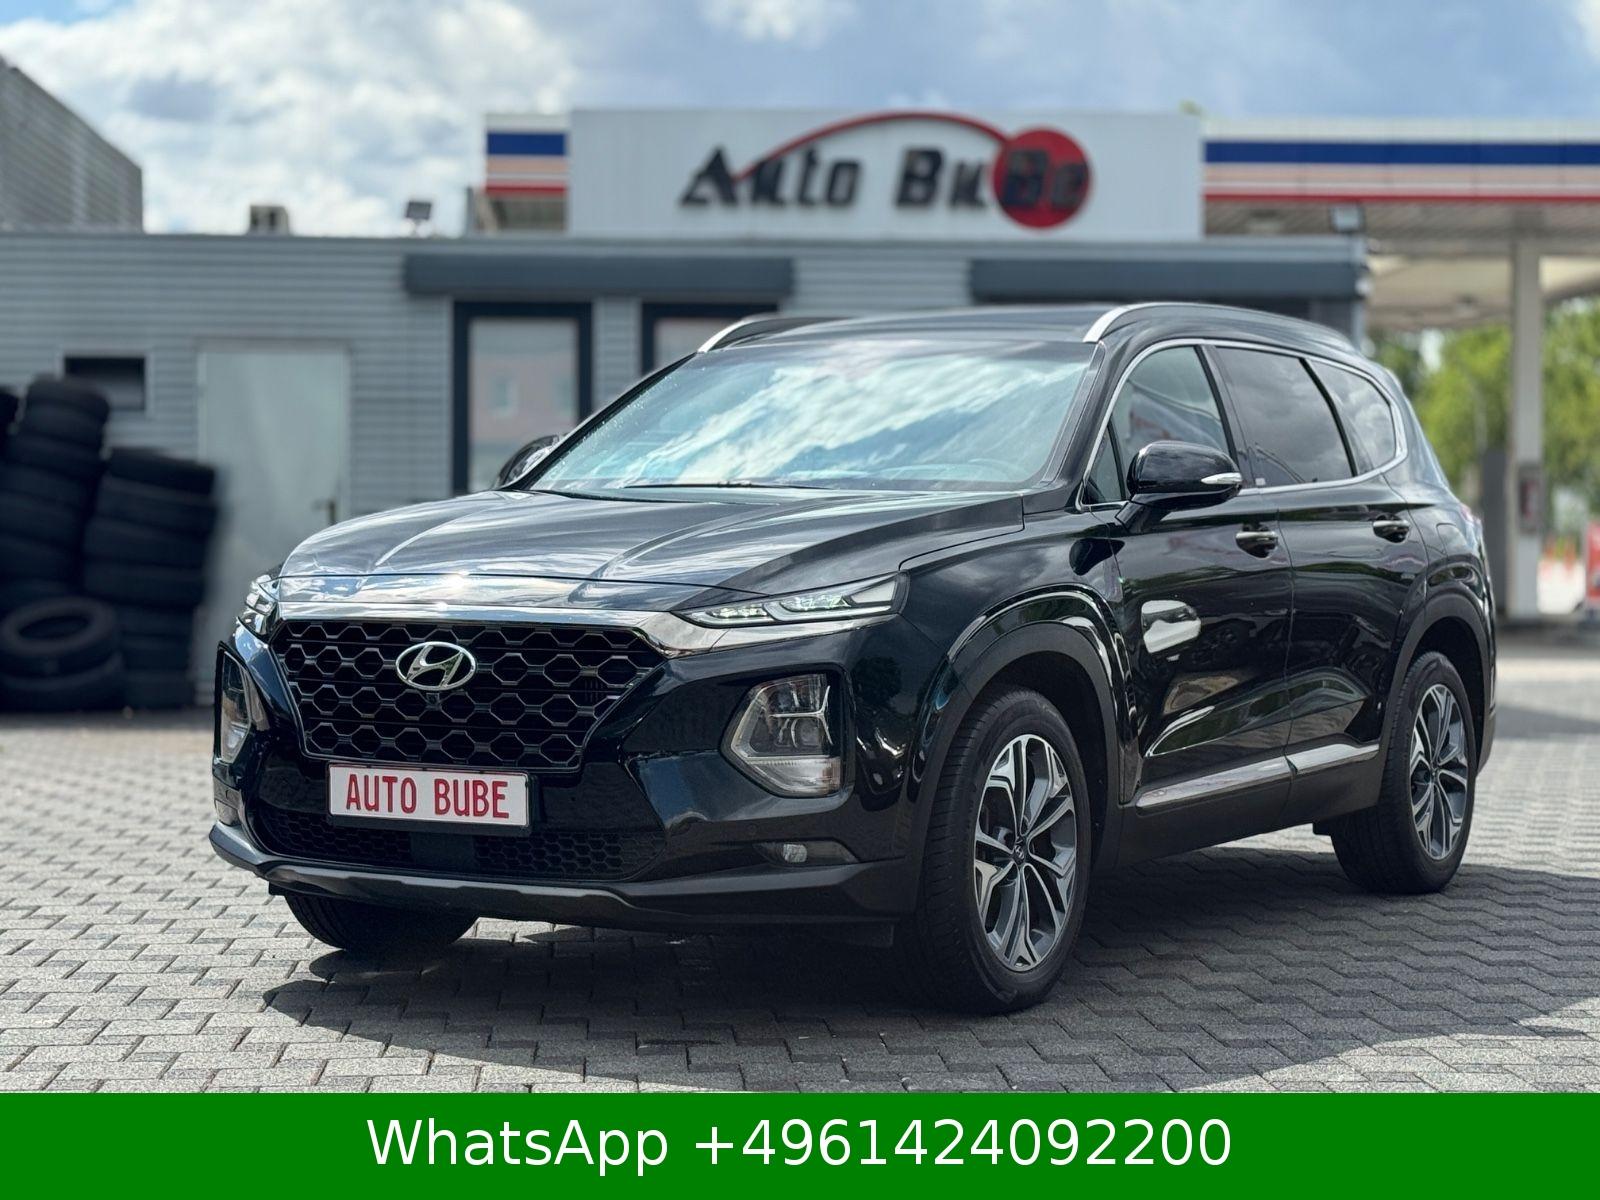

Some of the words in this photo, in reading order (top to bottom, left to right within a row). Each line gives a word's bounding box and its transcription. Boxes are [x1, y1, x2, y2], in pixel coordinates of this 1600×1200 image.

[680, 145, 862, 208] Auto
[346, 774, 417, 814] AUTO
[434, 778, 510, 818] BUBE
